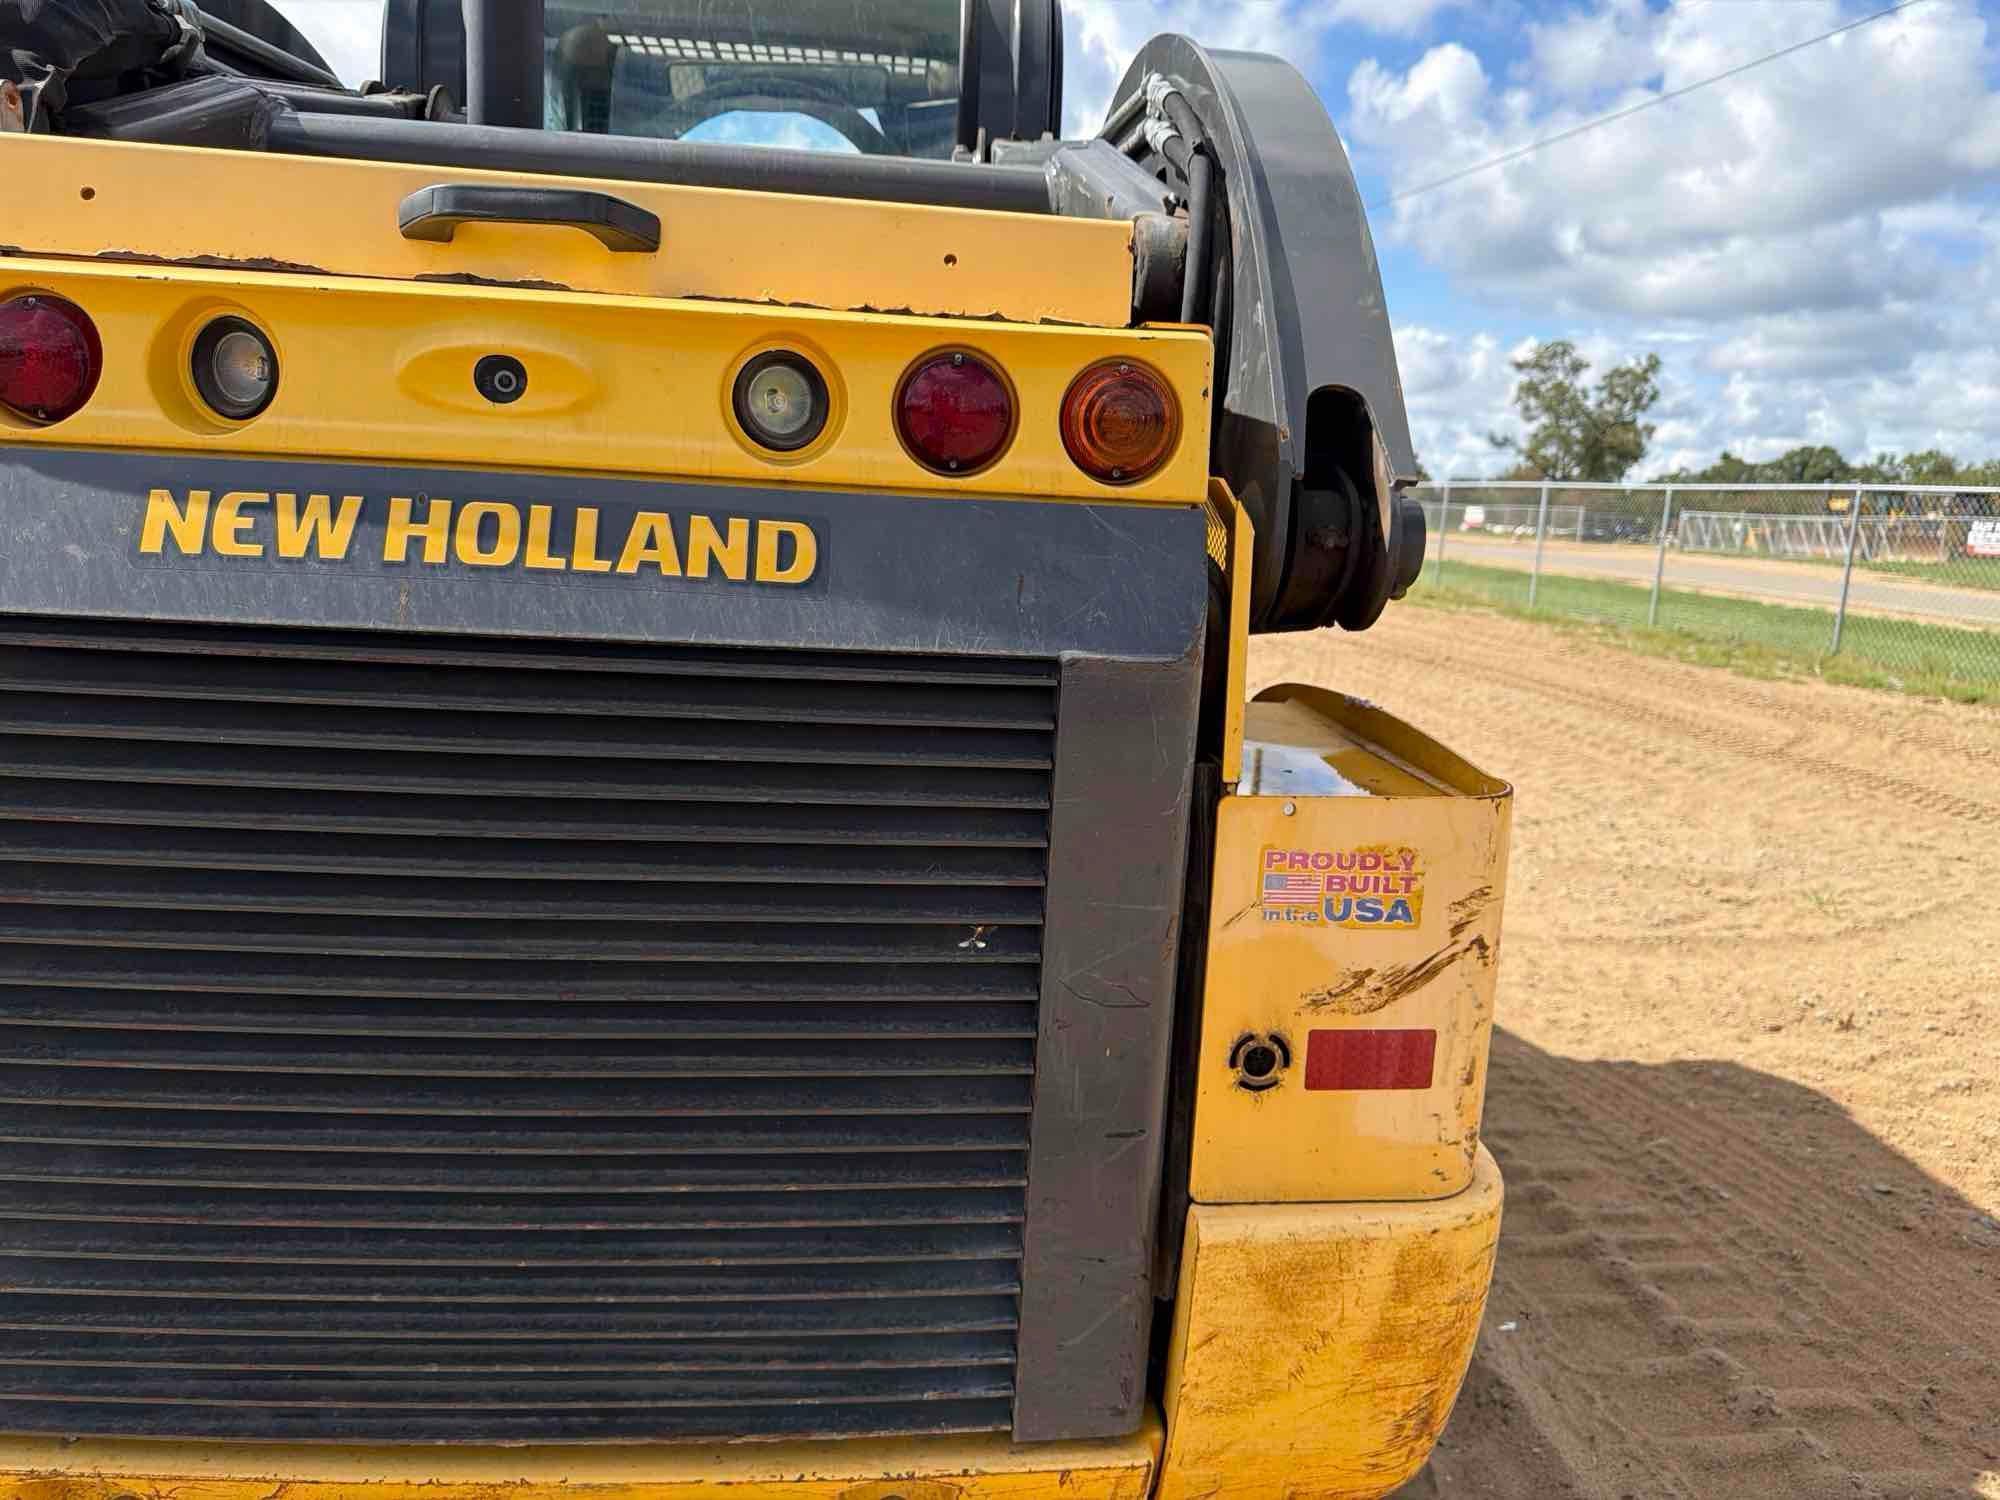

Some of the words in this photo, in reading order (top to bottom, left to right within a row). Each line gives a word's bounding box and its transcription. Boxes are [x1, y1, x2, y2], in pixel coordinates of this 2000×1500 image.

[140, 490, 364, 559] NEW
[384, 497, 817, 584] HOLLAND
[1265, 849, 1415, 871] PROUDLY
[1325, 875, 1418, 893] BUILT
[1324, 897, 1413, 922] USA
